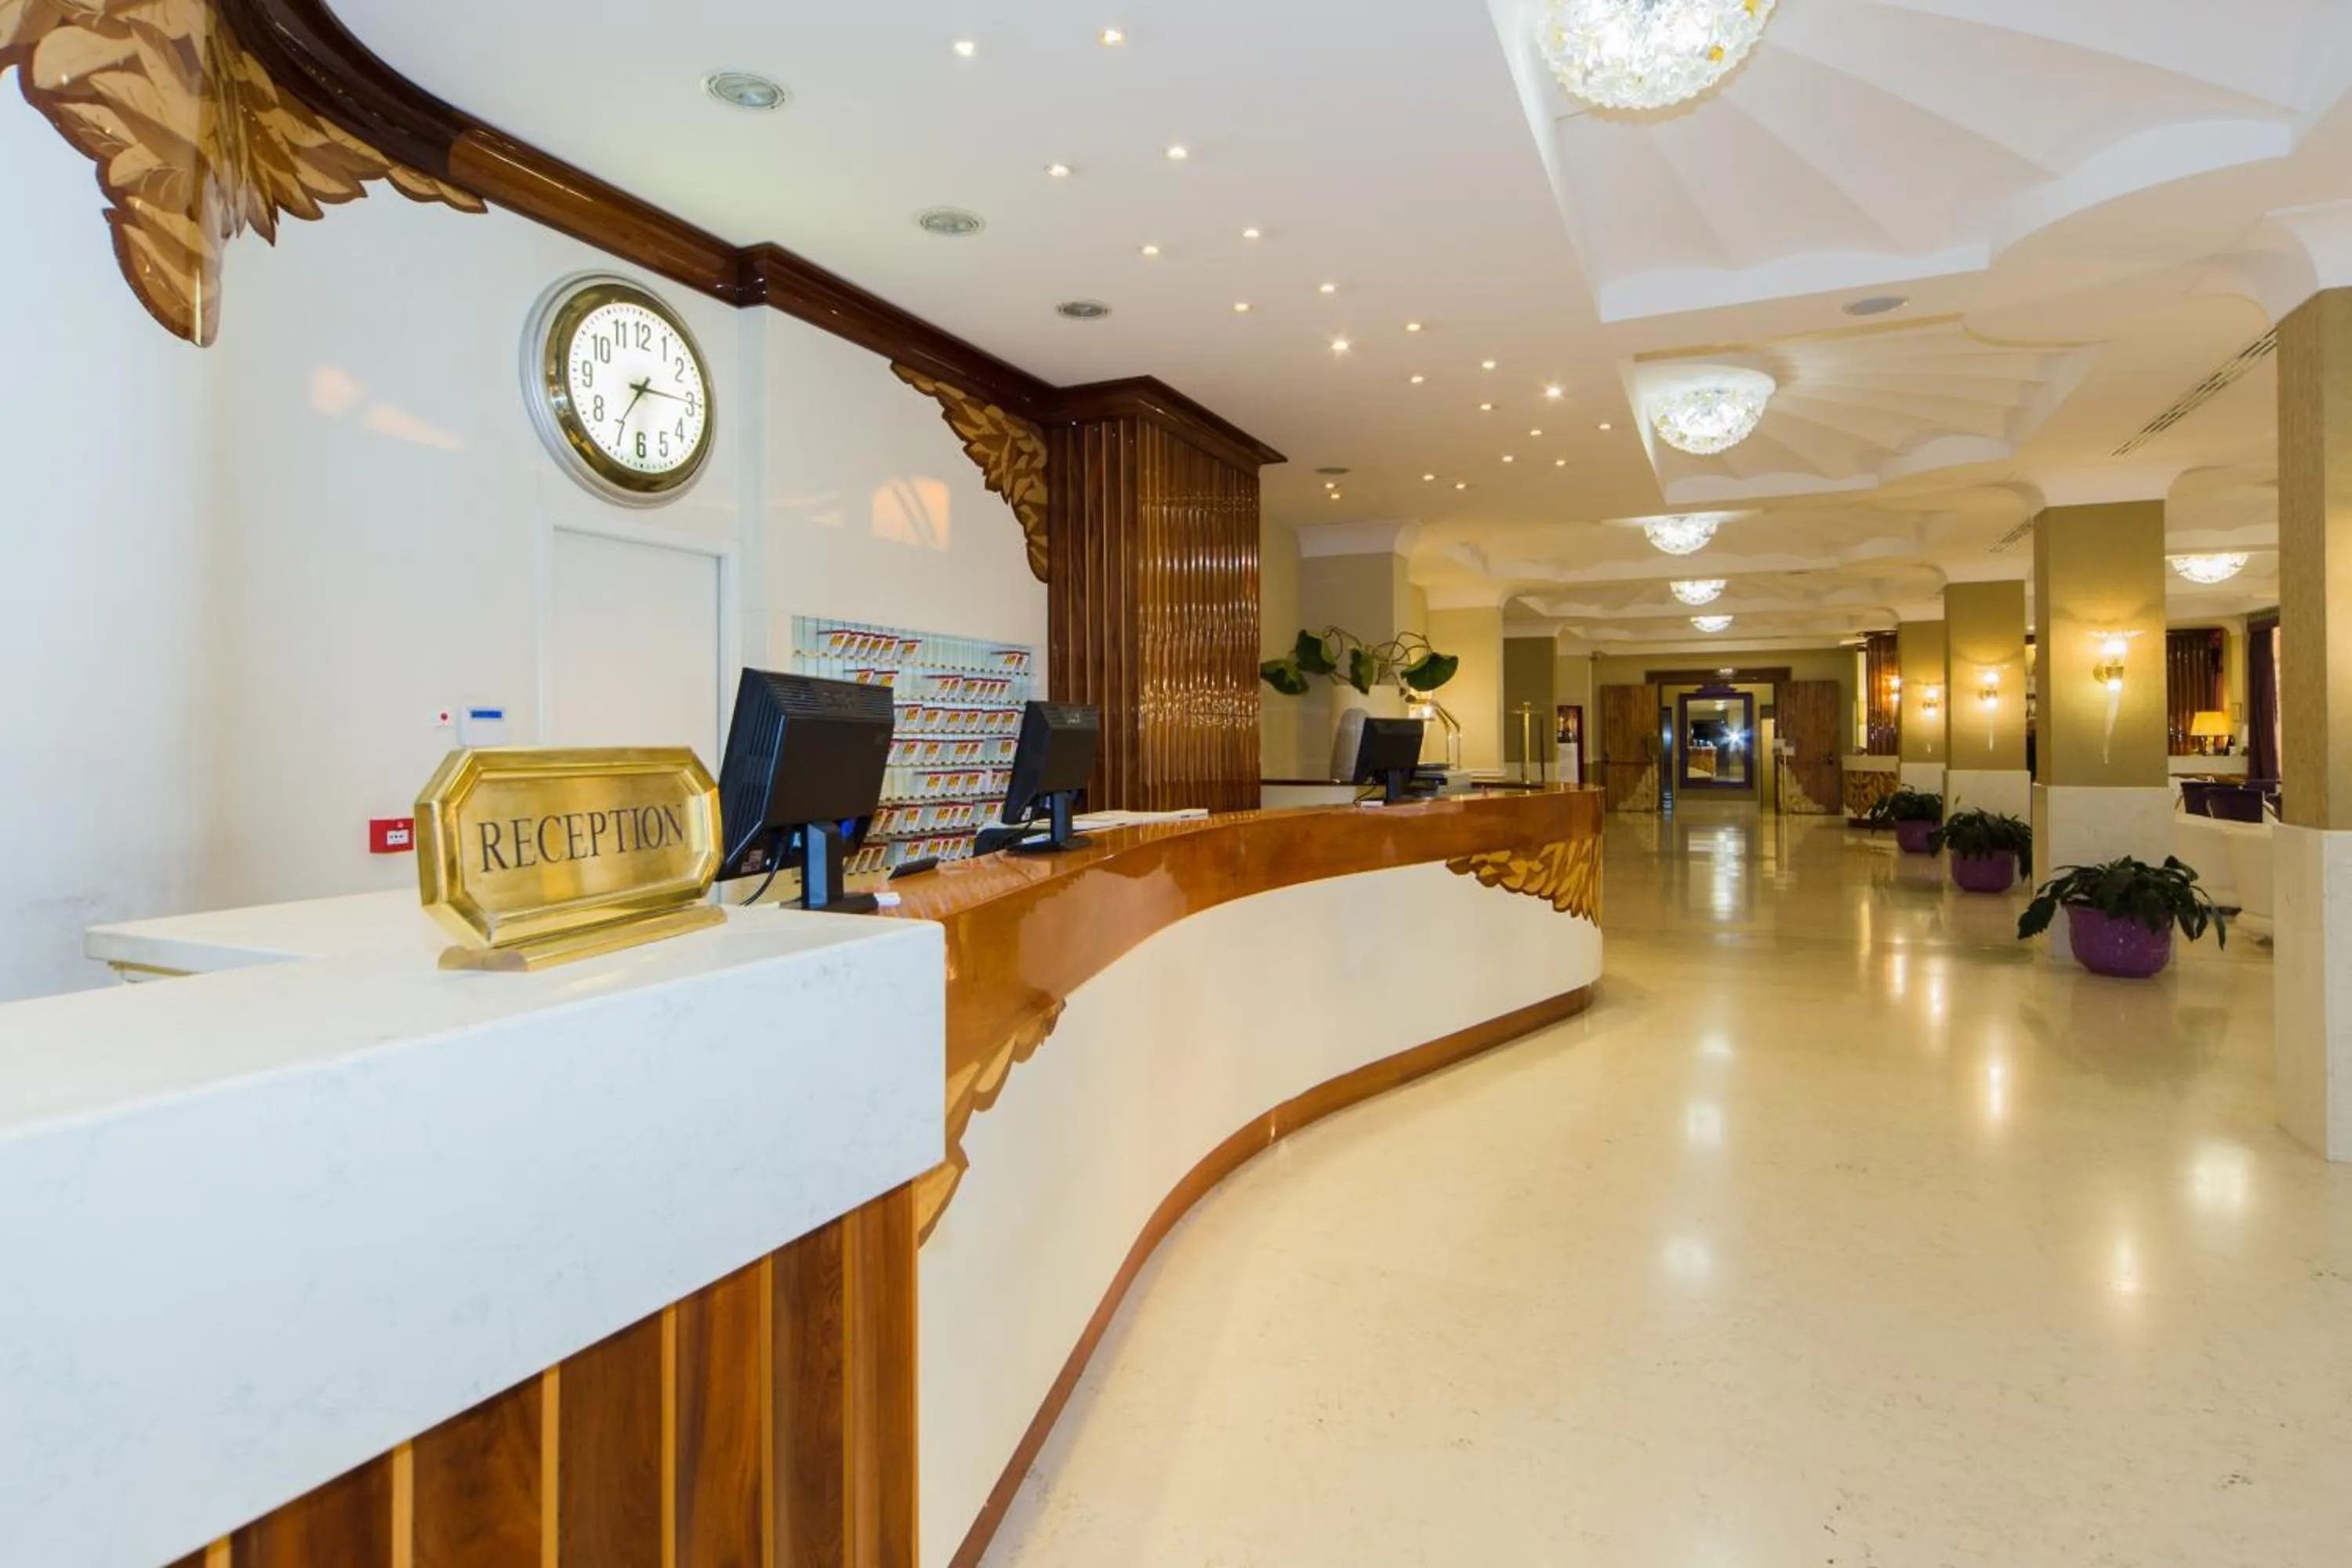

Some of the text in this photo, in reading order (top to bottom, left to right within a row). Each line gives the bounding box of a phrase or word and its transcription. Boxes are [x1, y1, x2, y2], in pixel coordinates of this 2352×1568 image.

[612, 318, 626, 349] 11
[633, 321, 652, 352] 12
[591, 332, 611, 364] 10
[661, 335, 667, 363] 1
[582, 360, 593, 387] 9
[675, 356, 684, 383] 2
[593, 394, 604, 422] 8
[685, 391, 695, 417] 3
[614, 418, 626, 446] 7
[674, 416, 684, 443] 4
[636, 430, 647, 459] 6
[659, 430, 669, 458] 5
[477, 804, 685, 873] RECEPTION
